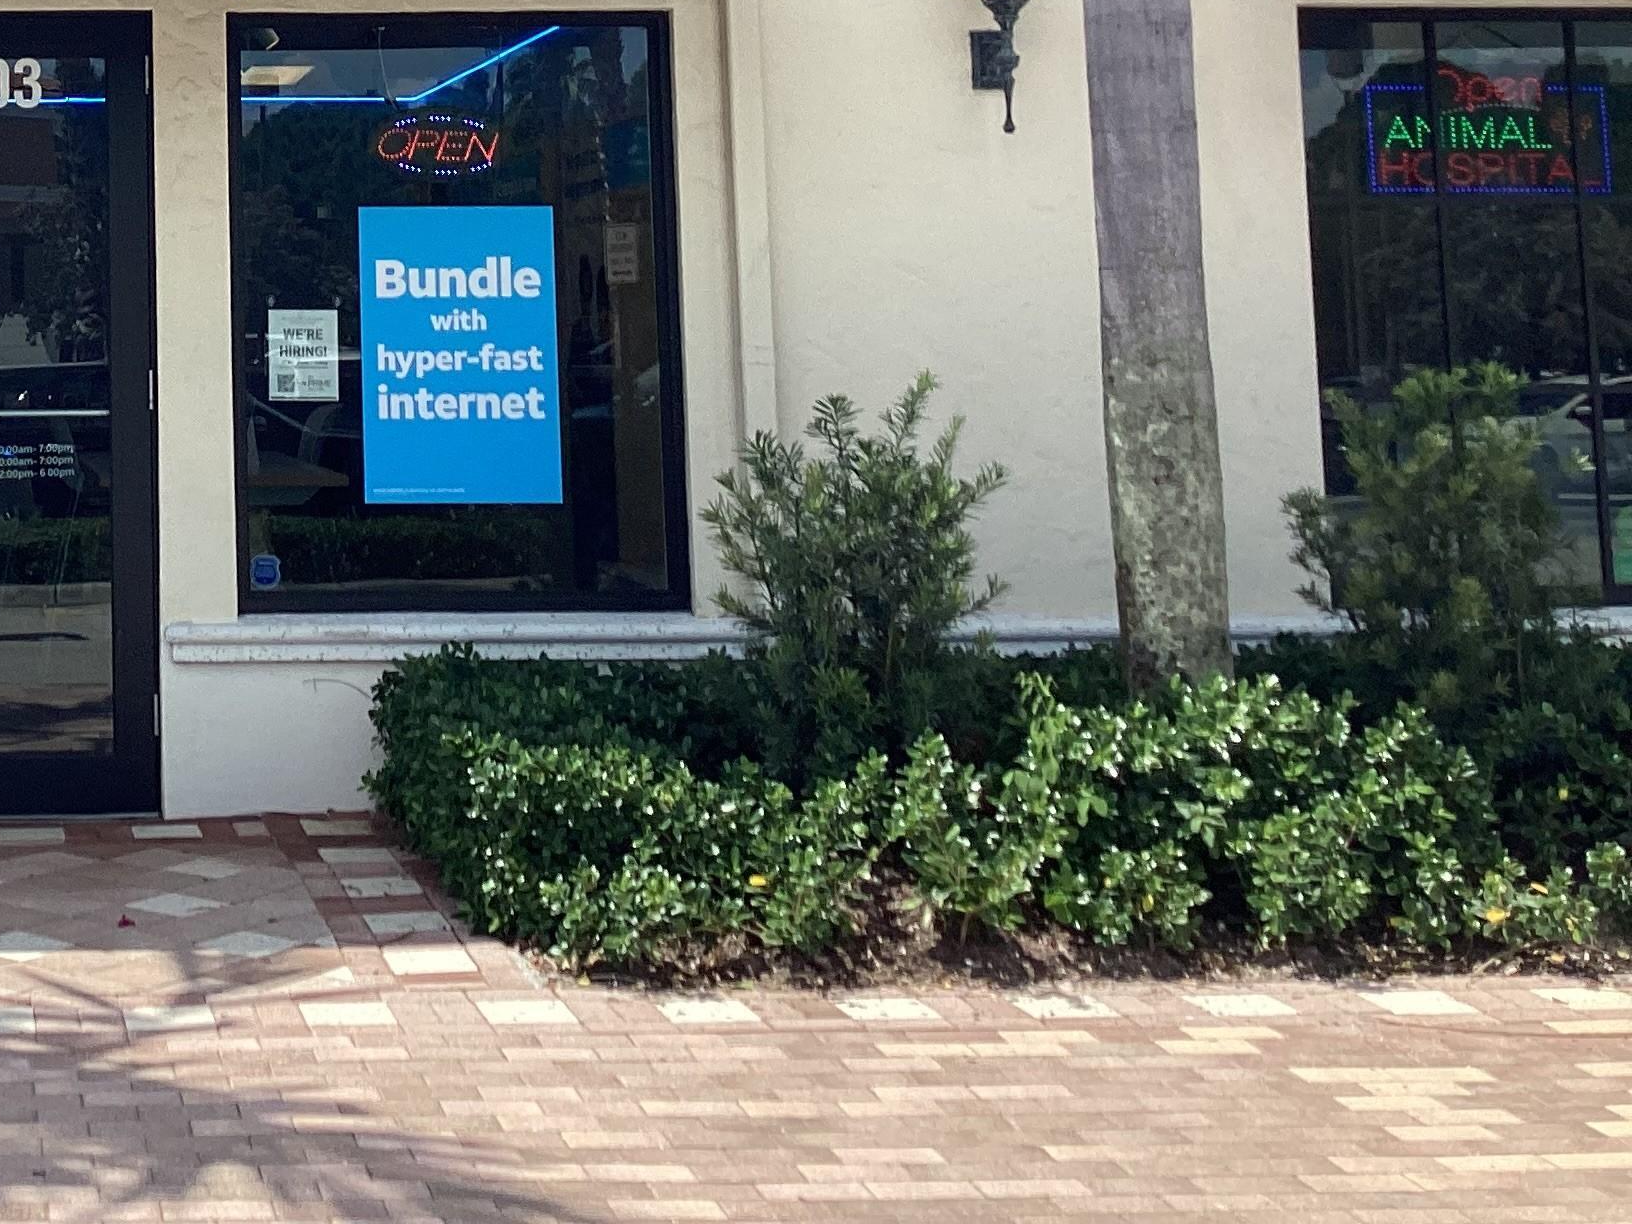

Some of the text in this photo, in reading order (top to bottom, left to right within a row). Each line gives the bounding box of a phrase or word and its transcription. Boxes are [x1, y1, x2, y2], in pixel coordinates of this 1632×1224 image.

[377, 128, 500, 162] OPEN
[1384, 116, 1553, 149] ANIMAL
[375, 256, 542, 299] Bundle
[283, 328, 323, 341] WE'RE
[430, 308, 488, 331] with
[279, 345, 328, 357] HIRING!
[377, 343, 544, 379] hyper-fast
[377, 383, 546, 420] internet
